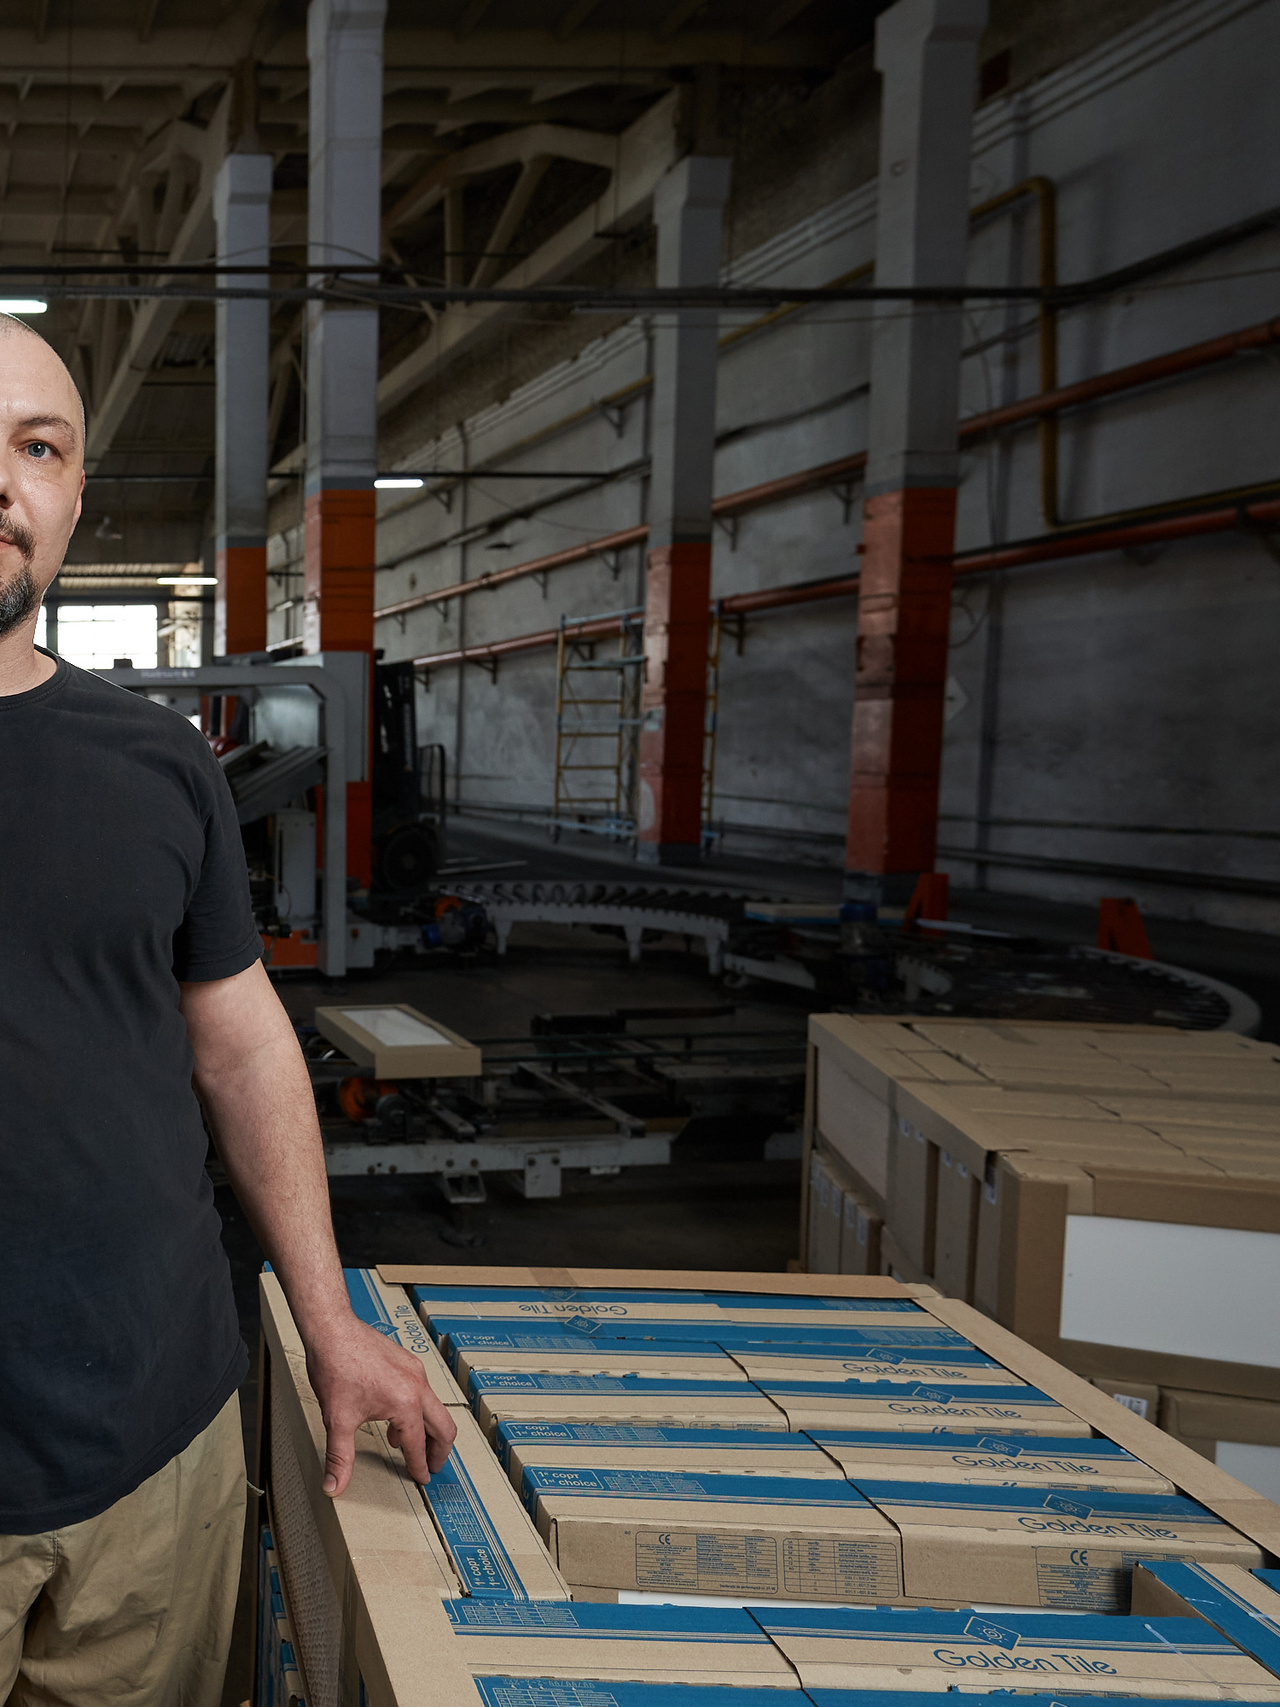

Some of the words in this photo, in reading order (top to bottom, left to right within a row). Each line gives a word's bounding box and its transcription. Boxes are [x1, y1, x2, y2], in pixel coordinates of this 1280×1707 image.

[393, 1304, 413, 1319] Tile
[518, 1304, 553, 1315] Tile
[554, 1304, 628, 1316] Golden
[403, 1320, 430, 1354] Golden
[842, 1363, 925, 1377] Golden
[925, 1367, 968, 1379] Tile
[499, 1379, 533, 1387] choice
[888, 1403, 977, 1416] Golden
[976, 1406, 1022, 1419] Tile
[530, 1430, 567, 1438] choice
[951, 1455, 1050, 1471] Golden
[1050, 1460, 1099, 1475] Tile
[559, 1478, 598, 1488] choice
[1017, 1516, 1129, 1536] Golden
[1126, 1523, 1178, 1540] Tile
[658, 1533, 671, 1545] CE
[477, 1548, 496, 1576] choice
[1070, 1549, 1088, 1566] CE
[933, 1648, 1060, 1672] Golden
[1051, 1653, 1118, 1675] Tile
